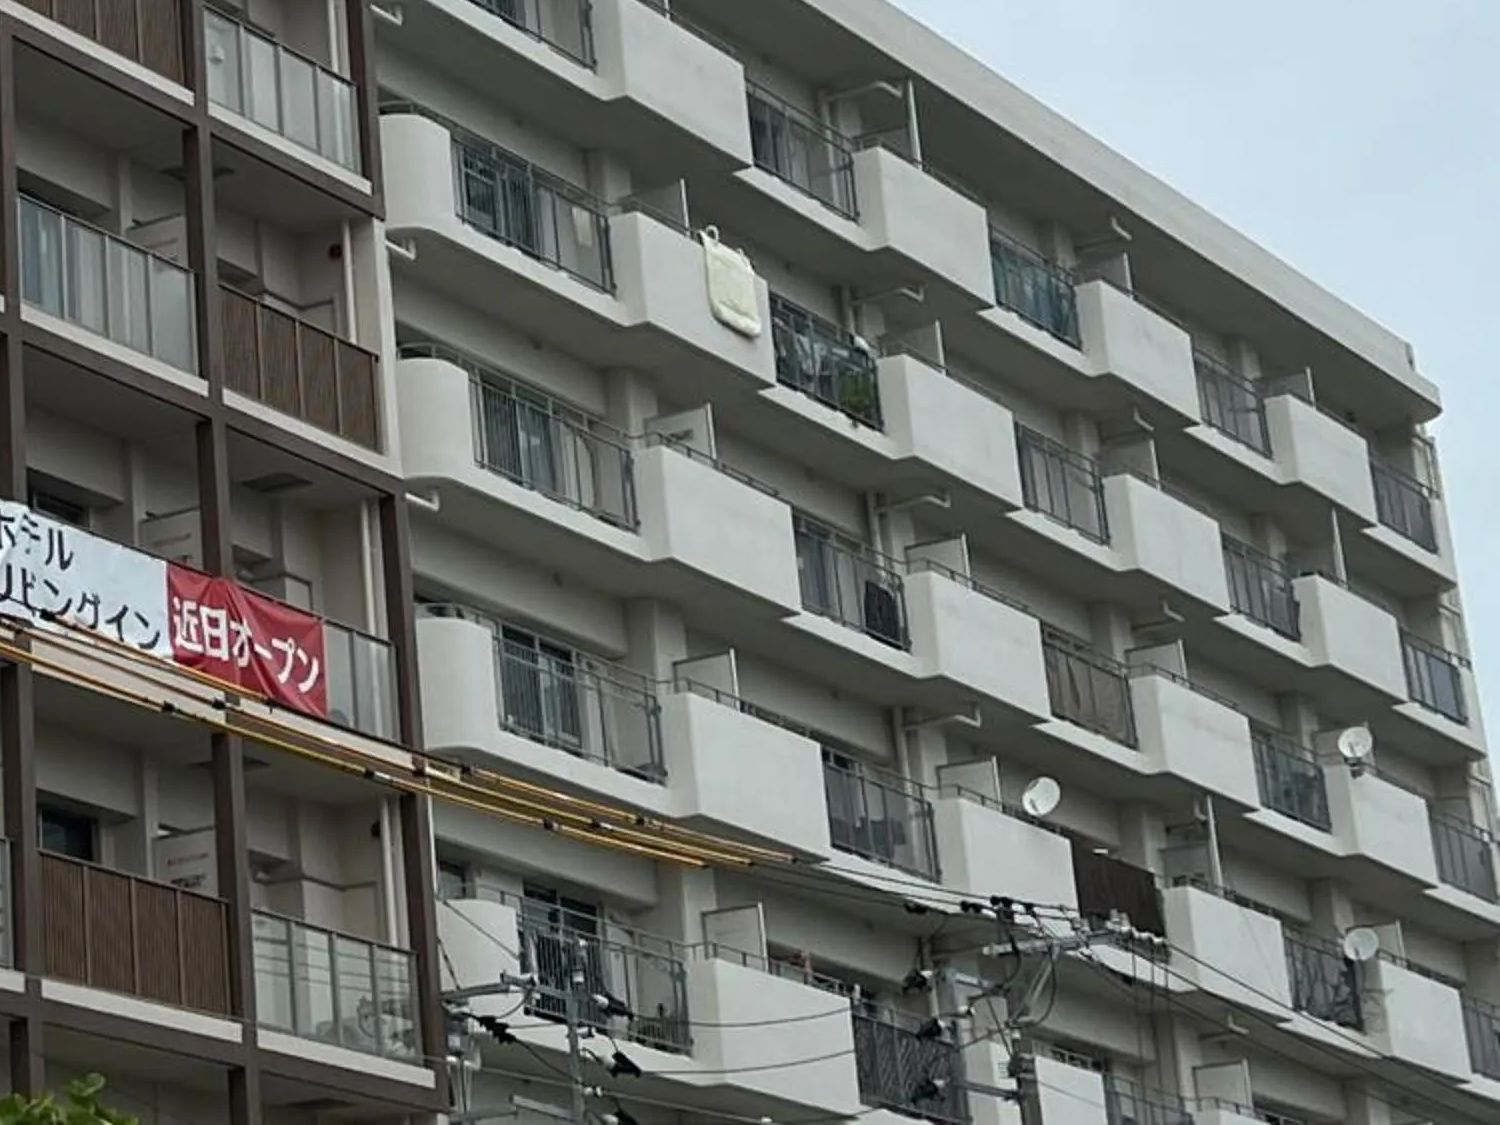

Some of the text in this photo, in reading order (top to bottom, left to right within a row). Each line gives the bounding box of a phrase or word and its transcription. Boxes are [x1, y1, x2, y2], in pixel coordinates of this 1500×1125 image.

[172, 596, 320, 693] 近日オープン
